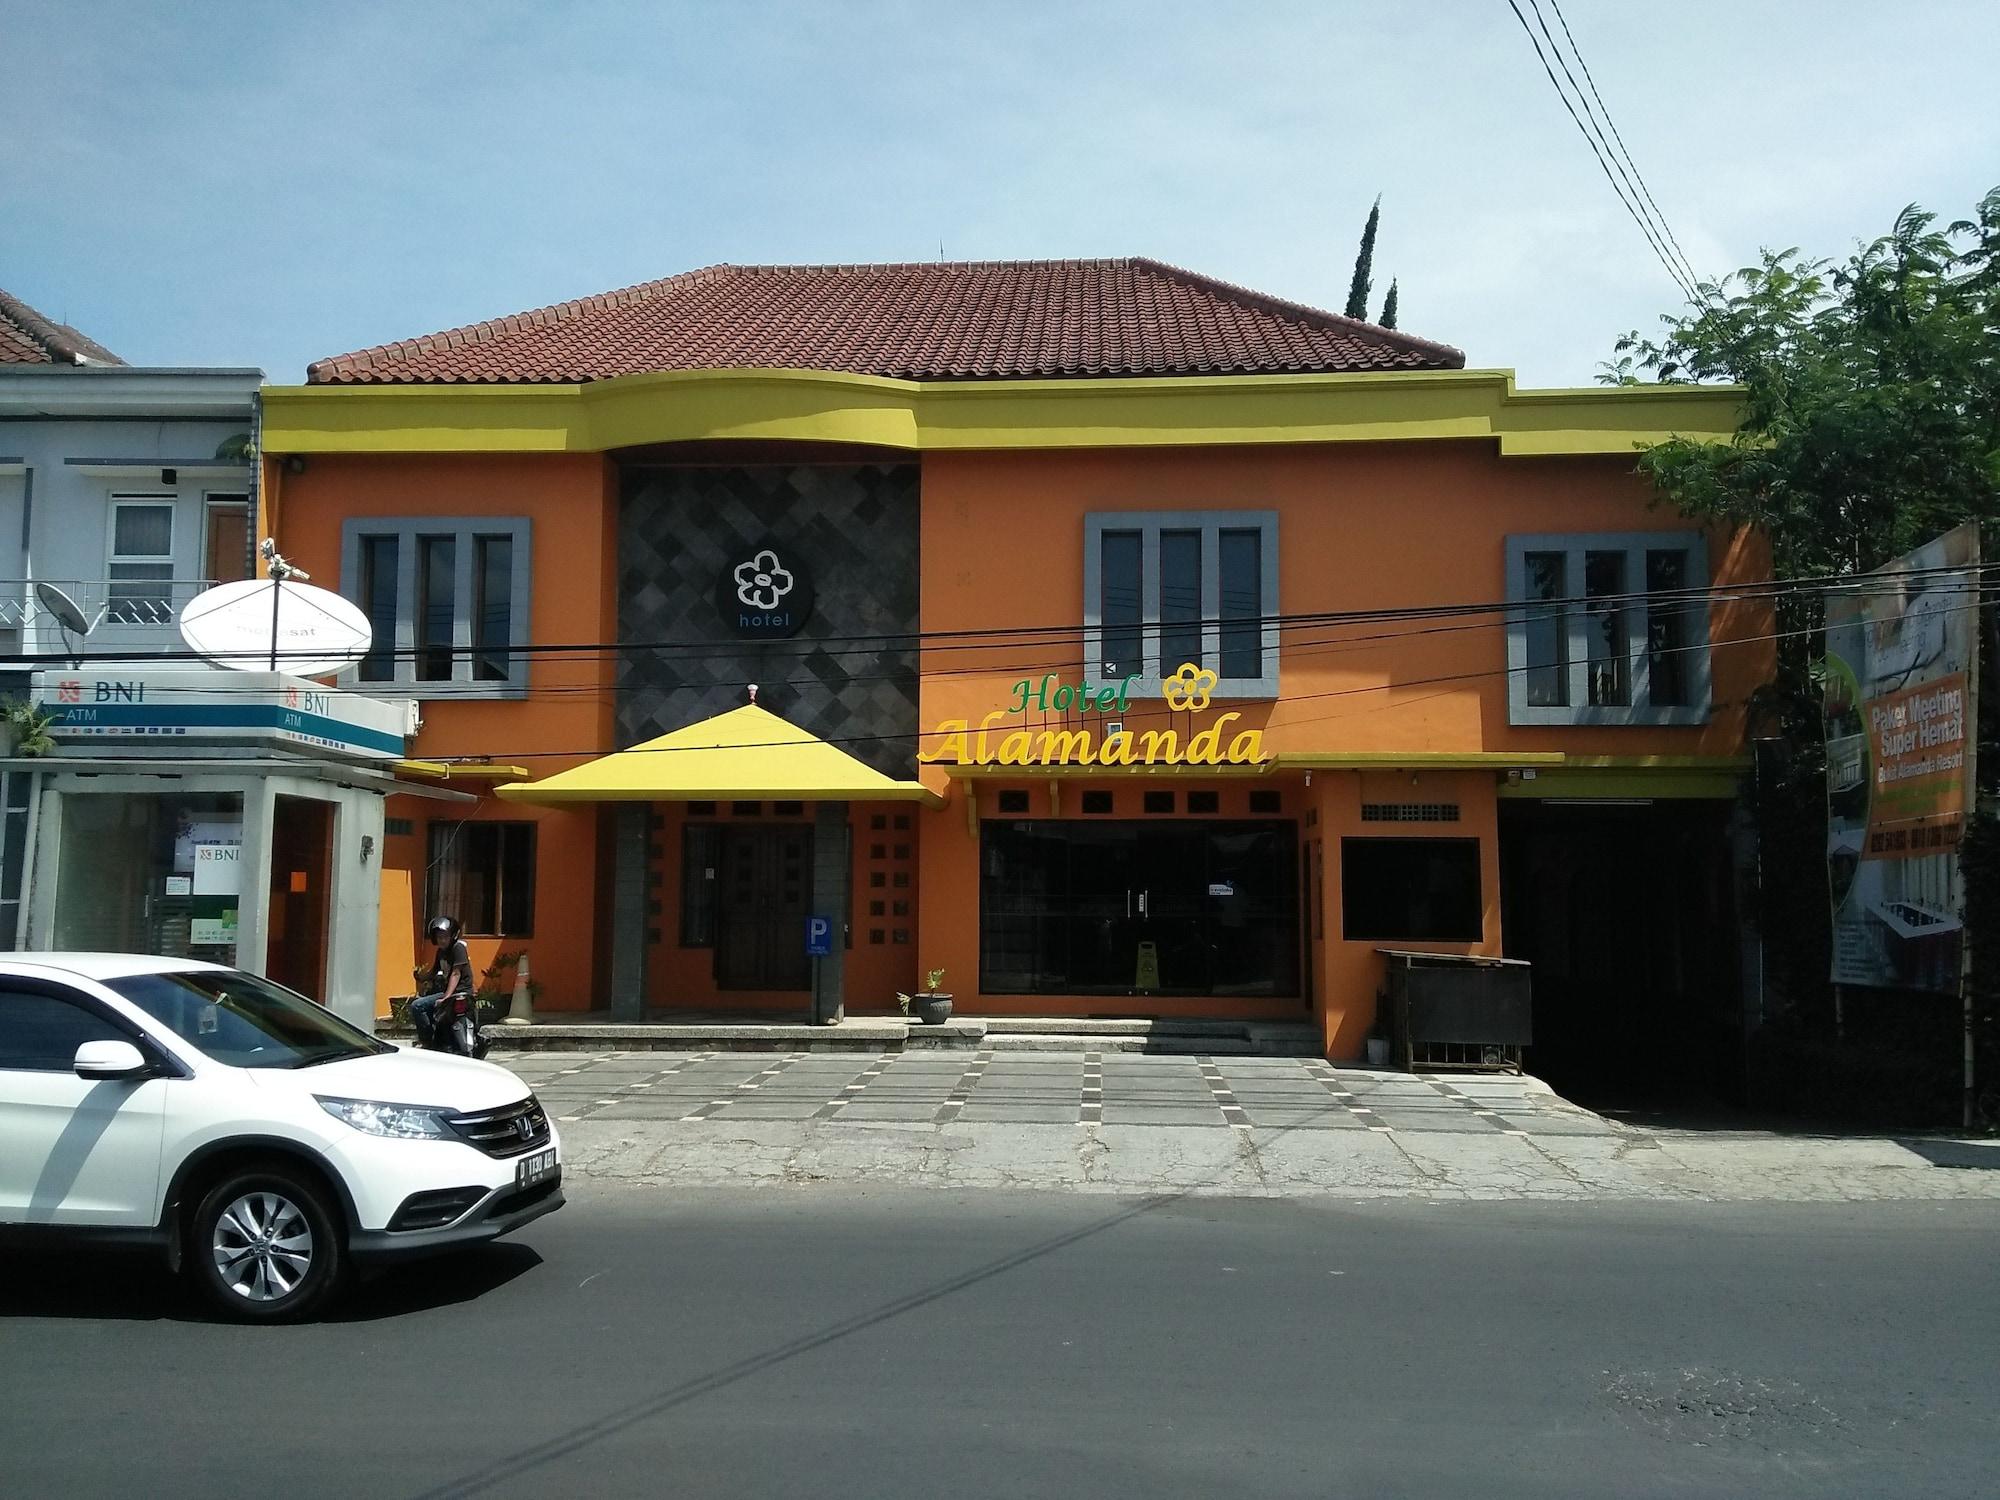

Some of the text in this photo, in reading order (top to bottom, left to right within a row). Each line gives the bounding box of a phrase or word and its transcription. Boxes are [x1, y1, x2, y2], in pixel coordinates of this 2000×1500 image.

[740, 613, 789, 627] hotel
[95, 681, 145, 702] BNI
[304, 691, 330, 716] BNI
[1008, 671, 1143, 714] Hotel
[66, 708, 97, 721] ATM
[284, 713, 302, 728] ATM
[1872, 687, 1963, 732] Paket Meeting
[916, 710, 1269, 766] Alamanda
[1881, 717, 1964, 760] Super Hemat
[214, 848, 239, 861] BNI
[811, 919, 827, 945] P
